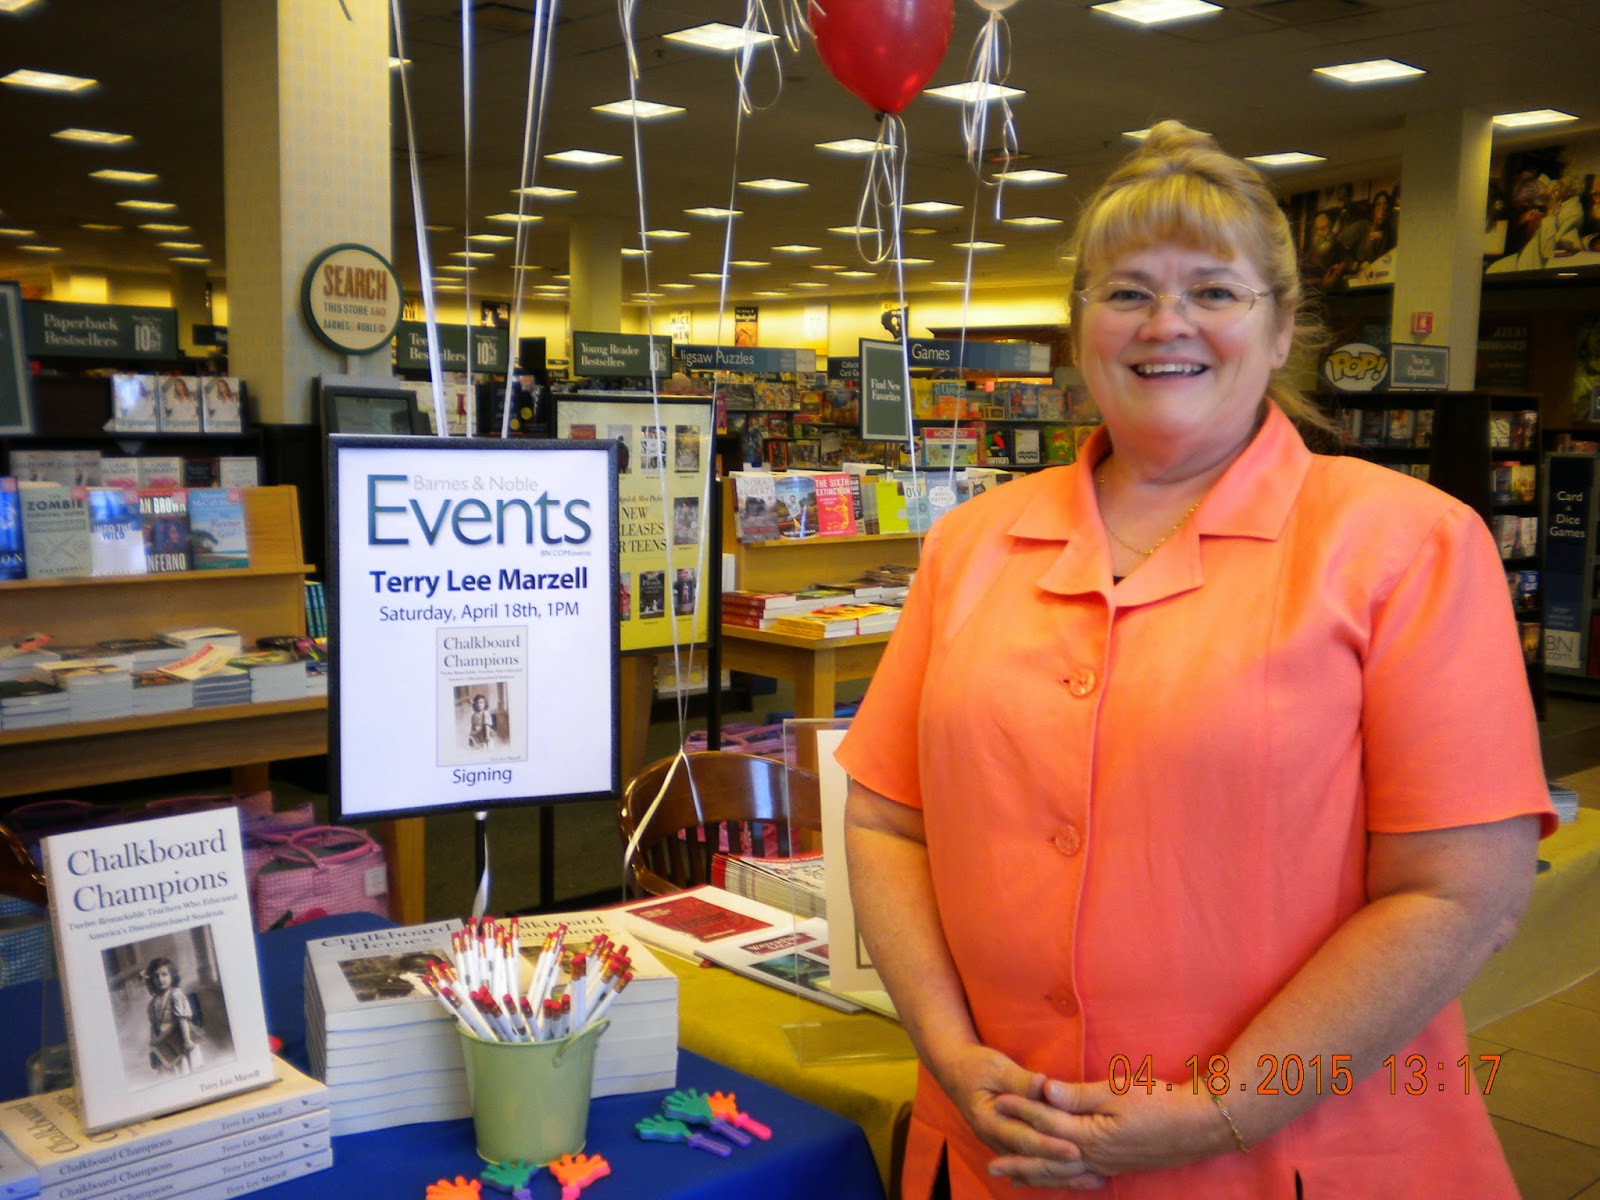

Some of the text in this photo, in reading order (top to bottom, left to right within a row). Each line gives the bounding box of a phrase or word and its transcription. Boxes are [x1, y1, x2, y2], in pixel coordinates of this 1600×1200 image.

[323, 264, 387, 300] SEARCH
[324, 301, 342, 314] THIS
[344, 303, 369, 316] STORE
[370, 306, 386, 317] AND
[43, 312, 119, 333] Paperback
[323, 319, 350, 332] BARNES
[356, 322, 378, 333] NOBLE
[671, 316, 690, 326] MICE
[44, 330, 118, 348] Bestsellers
[409, 332, 429, 346] Tee
[673, 331, 690, 341] MEN
[409, 347, 466, 362] Besellers
[581, 342, 608, 356] Young
[609, 344, 640, 356] Reader
[912, 343, 951, 361] Games
[581, 356, 626, 368] Bestsellers
[681, 350, 755, 367] Jigsaw Puzzles
[1327, 350, 1388, 382] POP!
[840, 369, 852, 377] Card
[871, 378, 901, 390] Find New
[871, 390, 901, 402] Favorites
[414, 475, 538, 492] Barnes & Noble
[815, 478, 850, 488] THE SIXTH
[738, 487, 775, 496] ROBERTS
[816, 487, 851, 496] EXTINCTION
[1557, 491, 1583, 502] Card
[26, 499, 84, 511] ZOMBIE
[139, 497, 151, 514] AN
[367, 474, 592, 546] Events
[622, 506, 649, 520] NEW
[1556, 514, 1581, 525] Dice
[619, 523, 665, 537] LEASES
[1550, 527, 1586, 538] Games
[629, 539, 667, 553] TEENS
[147, 552, 187, 572] NFERNO
[369, 567, 588, 598] Terry Lee Marzell
[379, 602, 580, 623] Saturday, April 18th, 1PM
[443, 635, 520, 650] Chalkboard
[1546, 635, 1574, 653] BN
[443, 653, 519, 669] Champions
[452, 767, 512, 787] Signing
[67, 828, 227, 877] Chalkboard
[73, 870, 229, 912] Champions
[69, 893, 239, 931] Twelve Remarkable Teachers Who Educated
[88, 926, 128, 941] America's
[191, 909, 225, 921] Students
[322, 923, 452, 949] Chalkboard
[350, 936, 433, 951] Heroes
[200, 1081, 219, 1092] Terry
[220, 1077, 233, 1087] Lee
[242, 1116, 255, 1124] Lee
[59, 1138, 173, 1176] Chalkboard Champions
[59, 1161, 173, 1199] Chalkboard Champions
